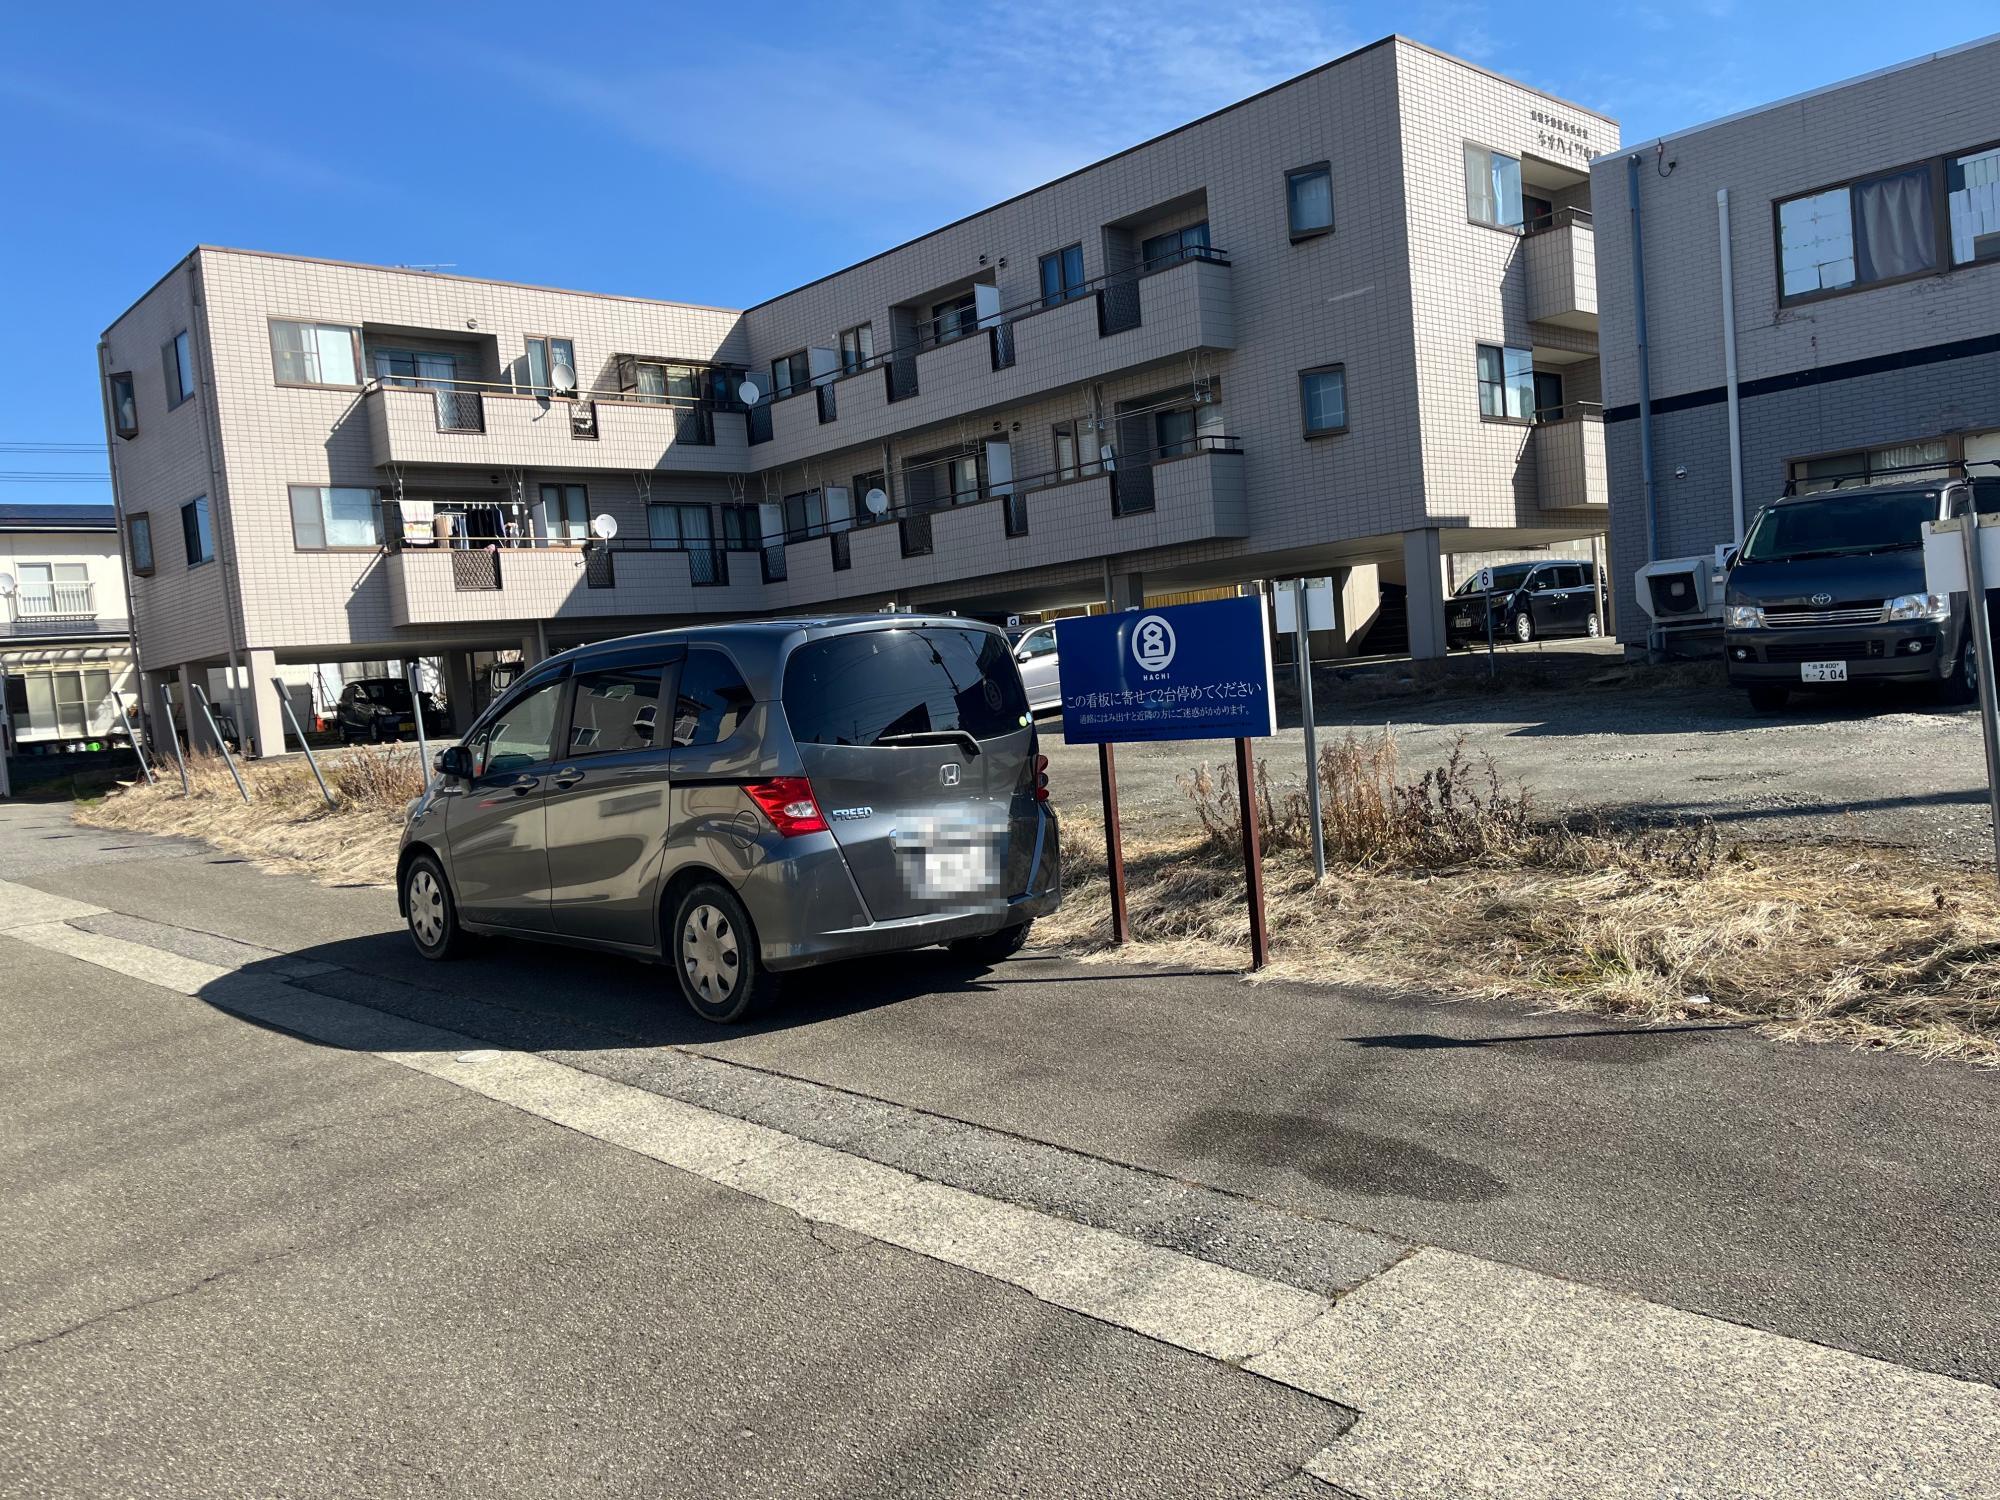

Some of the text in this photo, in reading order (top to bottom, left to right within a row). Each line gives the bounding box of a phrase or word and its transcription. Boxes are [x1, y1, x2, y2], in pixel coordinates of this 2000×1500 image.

[1482, 571, 1489, 586] 6
[1143, 672, 1170, 681] HACHI
[1066, 682, 1262, 709] この看板に寄せて2台停めてください
[832, 806, 873, 821] FREED
